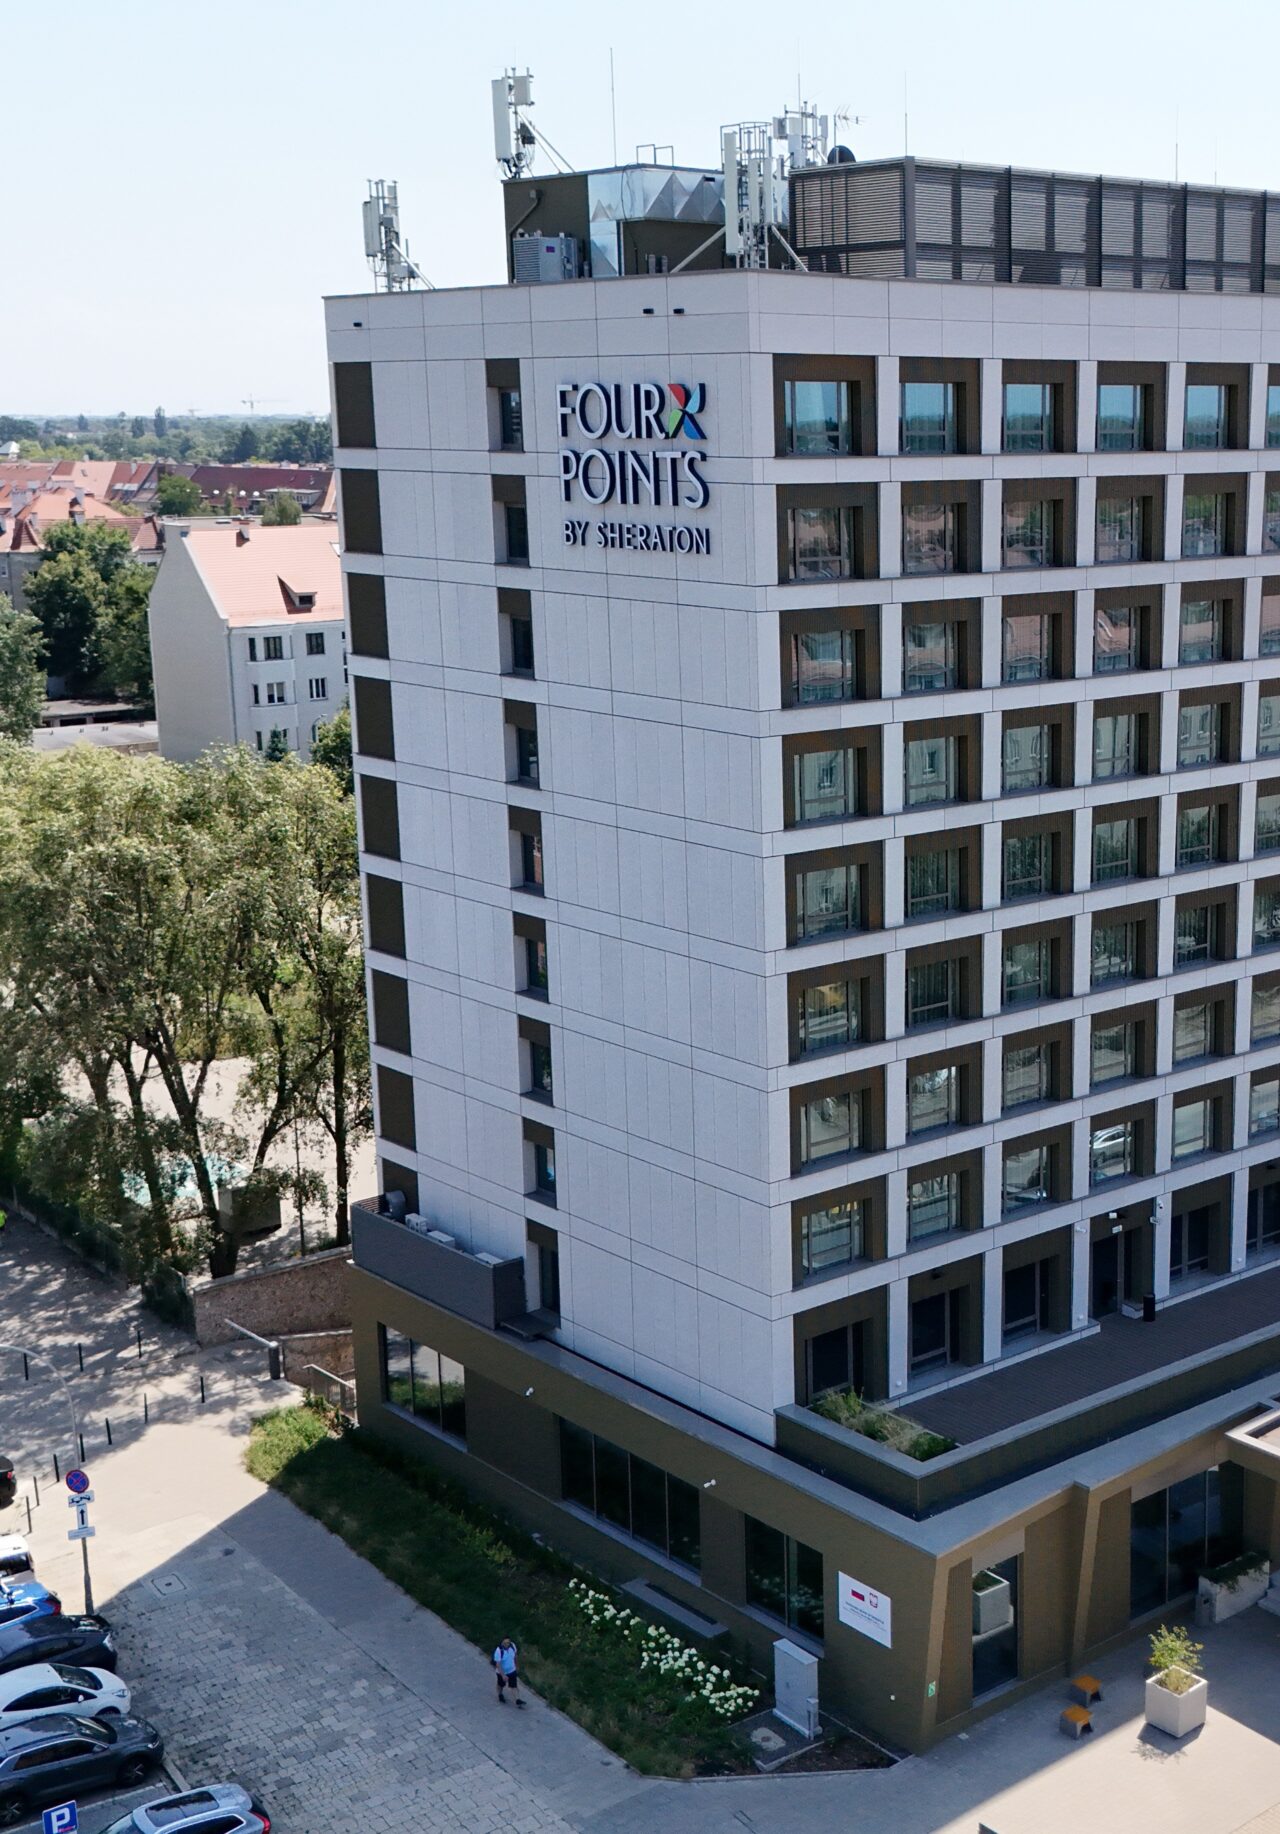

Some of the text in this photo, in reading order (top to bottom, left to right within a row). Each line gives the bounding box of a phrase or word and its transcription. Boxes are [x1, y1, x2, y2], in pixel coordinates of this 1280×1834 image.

[556, 383, 666, 440] FOUR
[559, 449, 709, 509] POINTS
[564, 521, 711, 555] BY SHERATON
[51, 1807, 70, 1834] P
